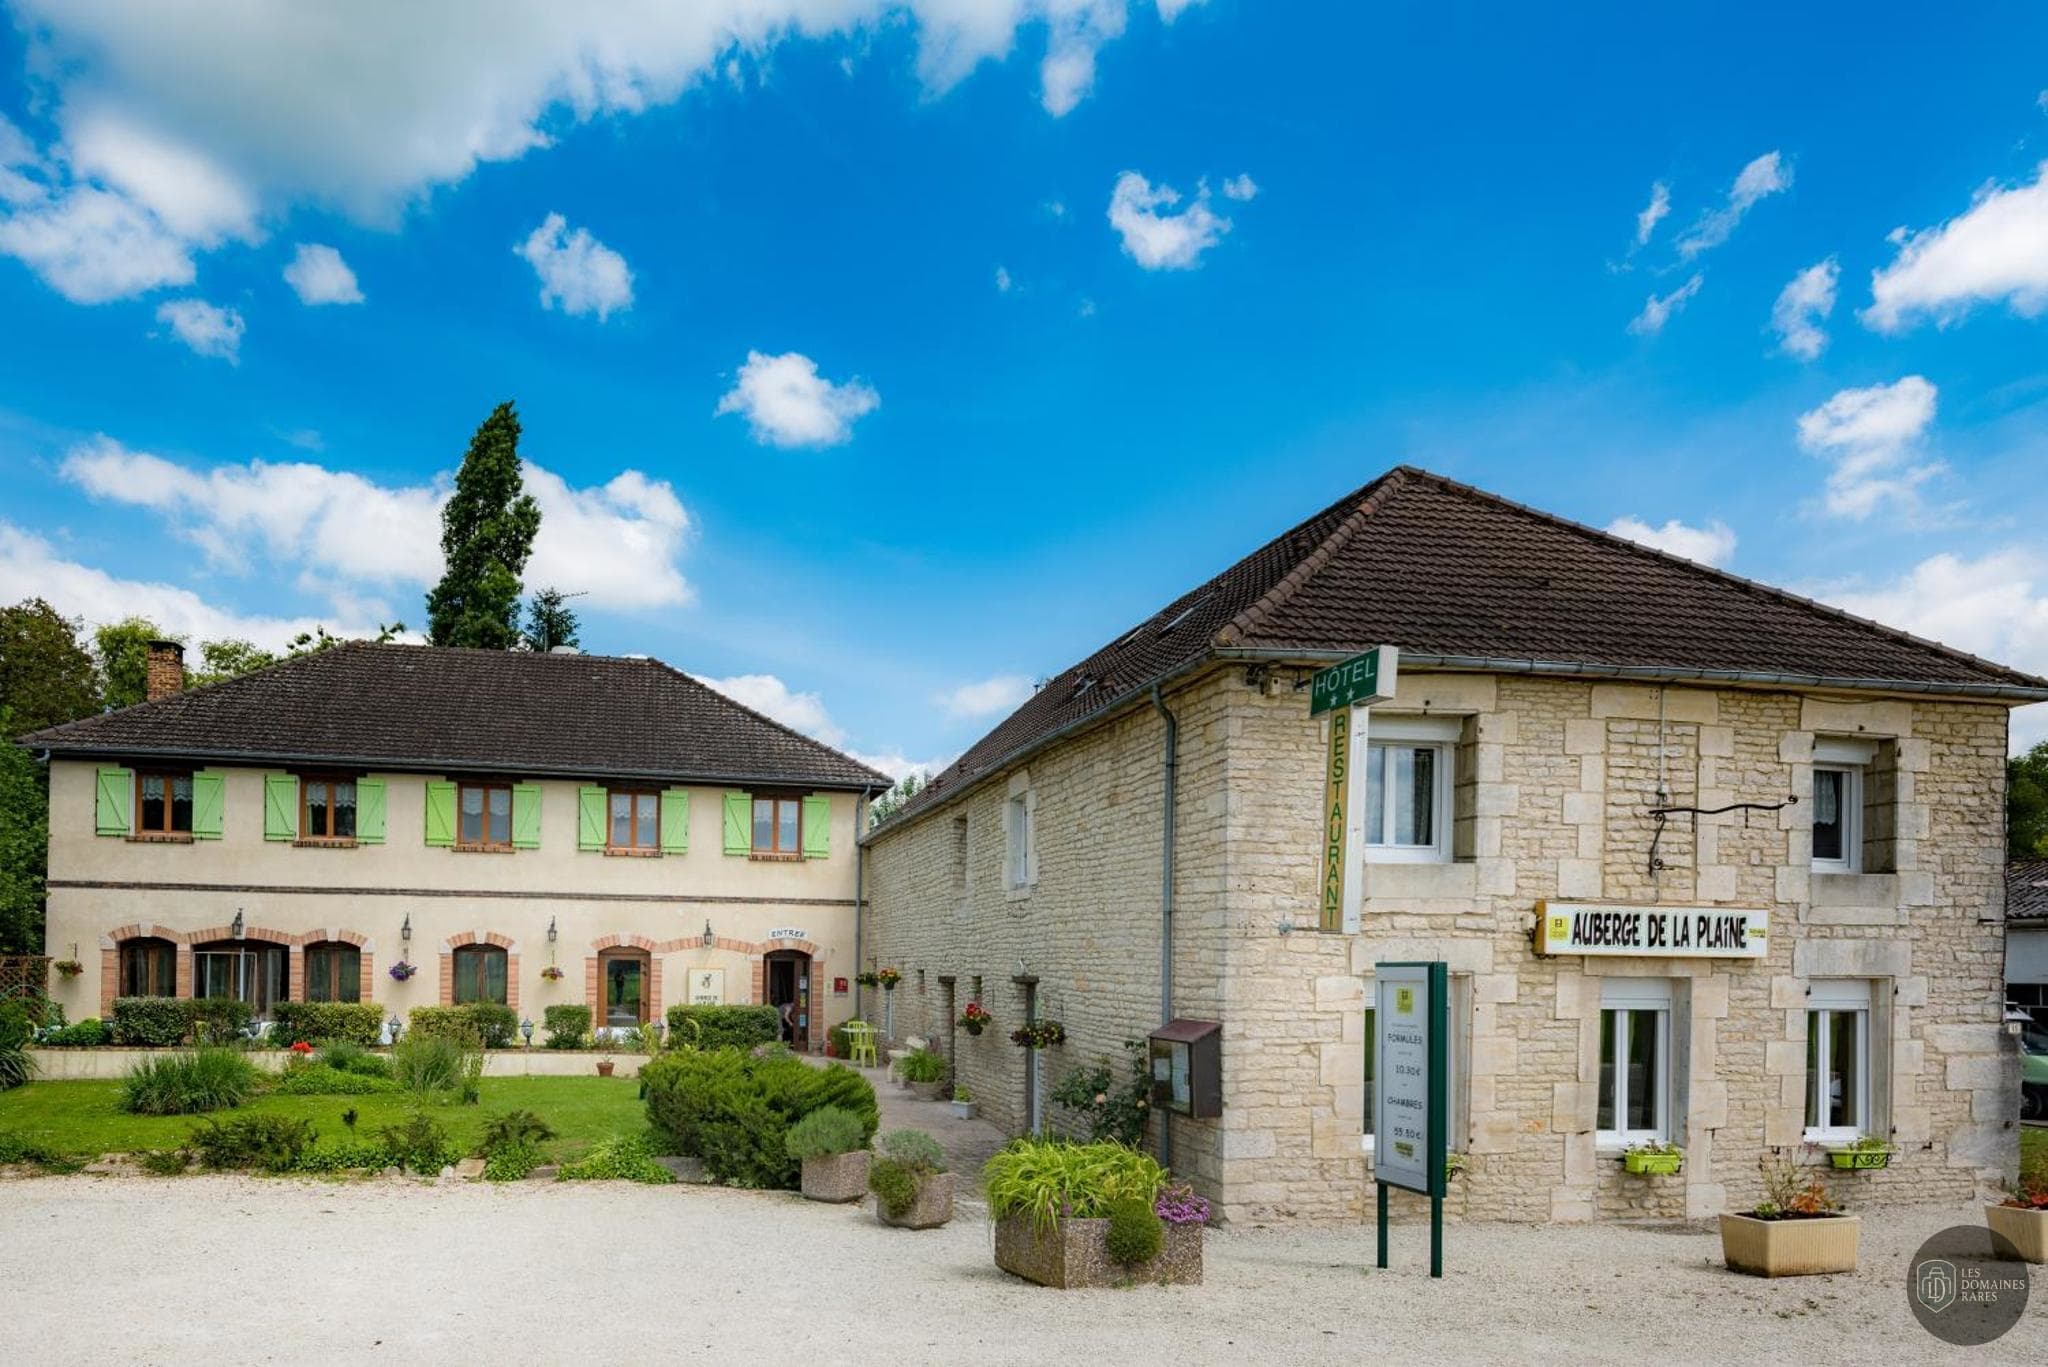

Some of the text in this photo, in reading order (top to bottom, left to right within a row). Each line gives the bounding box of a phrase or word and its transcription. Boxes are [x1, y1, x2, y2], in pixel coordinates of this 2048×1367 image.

[1326, 715, 1345, 928] RESTAURANT
[1572, 912, 1641, 946] AUBERGE
[1648, 914, 1666, 947] DE
[1673, 915, 1690, 947] LA
[1387, 1096, 1424, 1110] CHAMBRES
